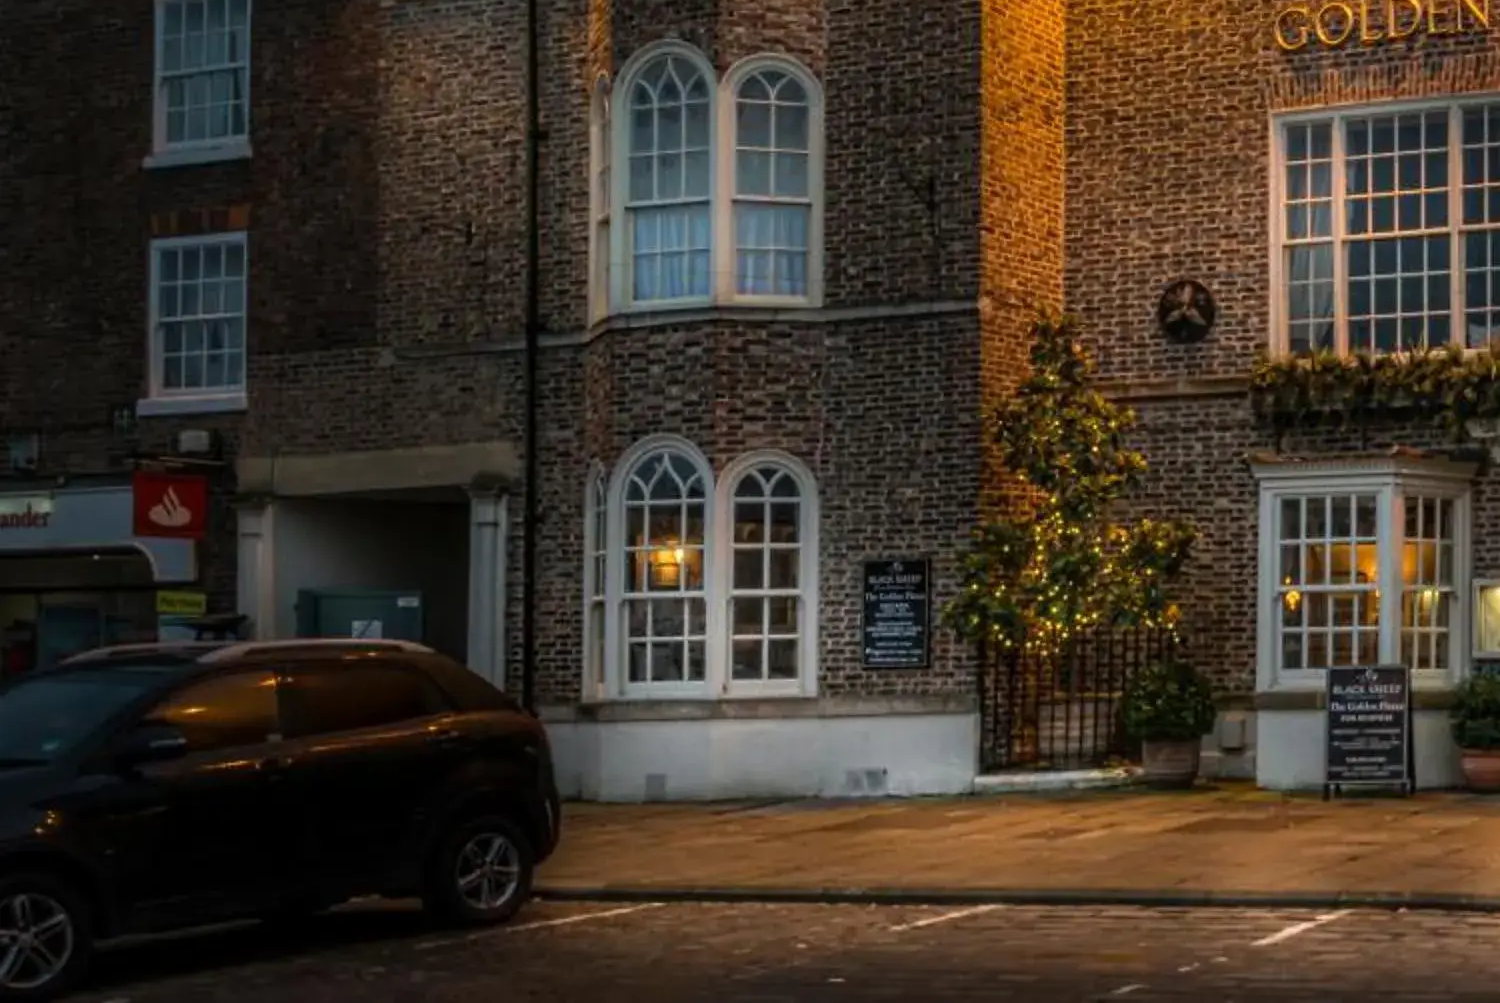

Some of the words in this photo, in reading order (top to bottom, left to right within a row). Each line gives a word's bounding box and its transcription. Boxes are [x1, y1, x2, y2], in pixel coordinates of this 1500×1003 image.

[1333, 685, 1364, 694] BLACK
[1331, 701, 1345, 711] The
[1347, 701, 1377, 711] Golden
